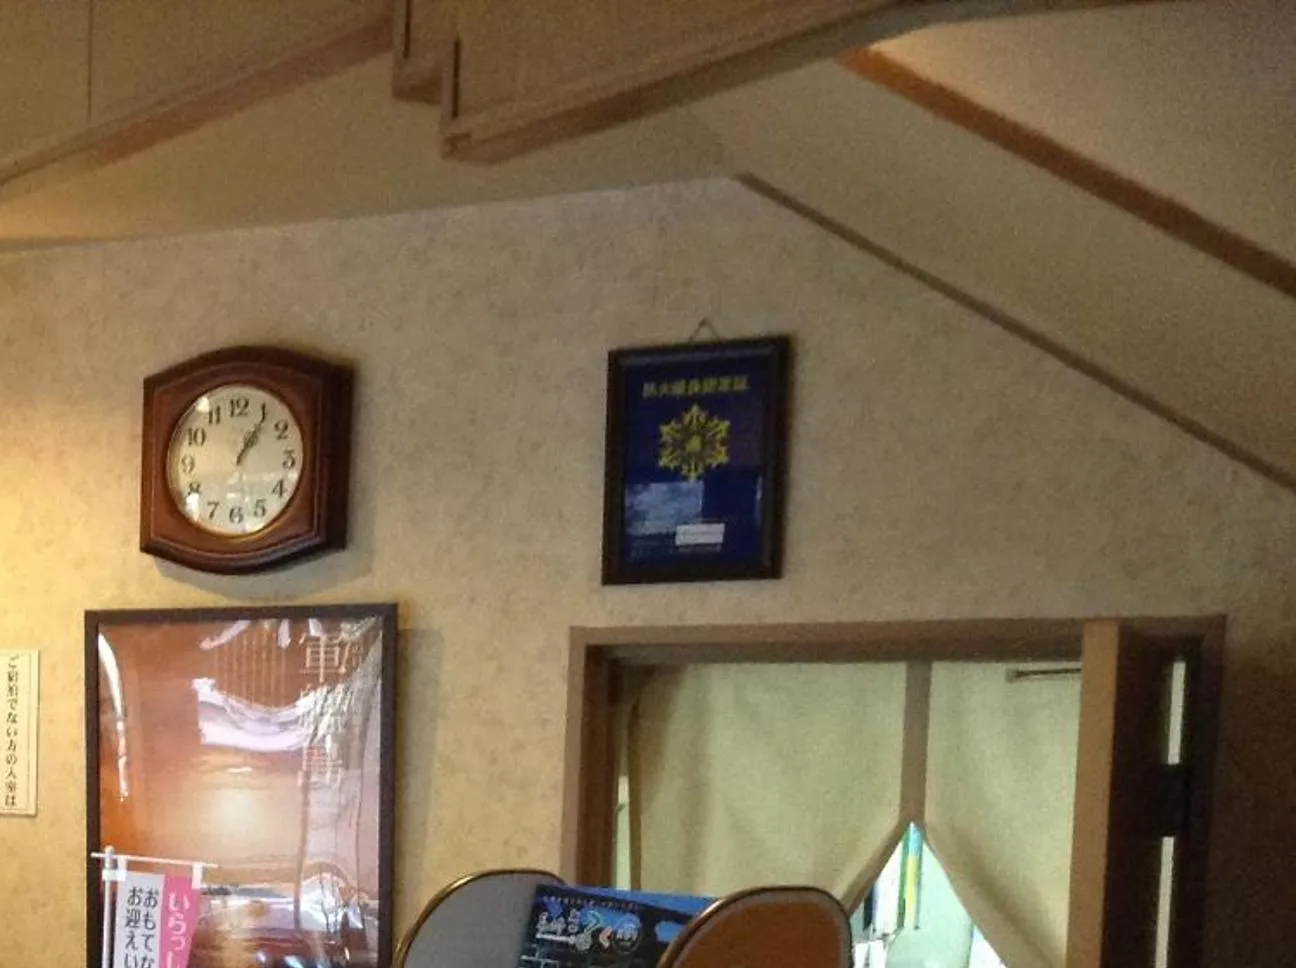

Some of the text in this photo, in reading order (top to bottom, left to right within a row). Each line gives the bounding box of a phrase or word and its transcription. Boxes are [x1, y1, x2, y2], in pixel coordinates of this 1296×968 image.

[207, 406, 222, 425] 11
[228, 396, 249, 417] 12
[187, 428, 206, 447] 10
[274, 420, 289, 440] 2
[182, 456, 195, 473] 9
[282, 450, 296, 469] 3
[272, 479, 286, 498] 4
[207, 501, 220, 520] 7
[229, 506, 244, 524] 6
[254, 498, 266, 518] 5
